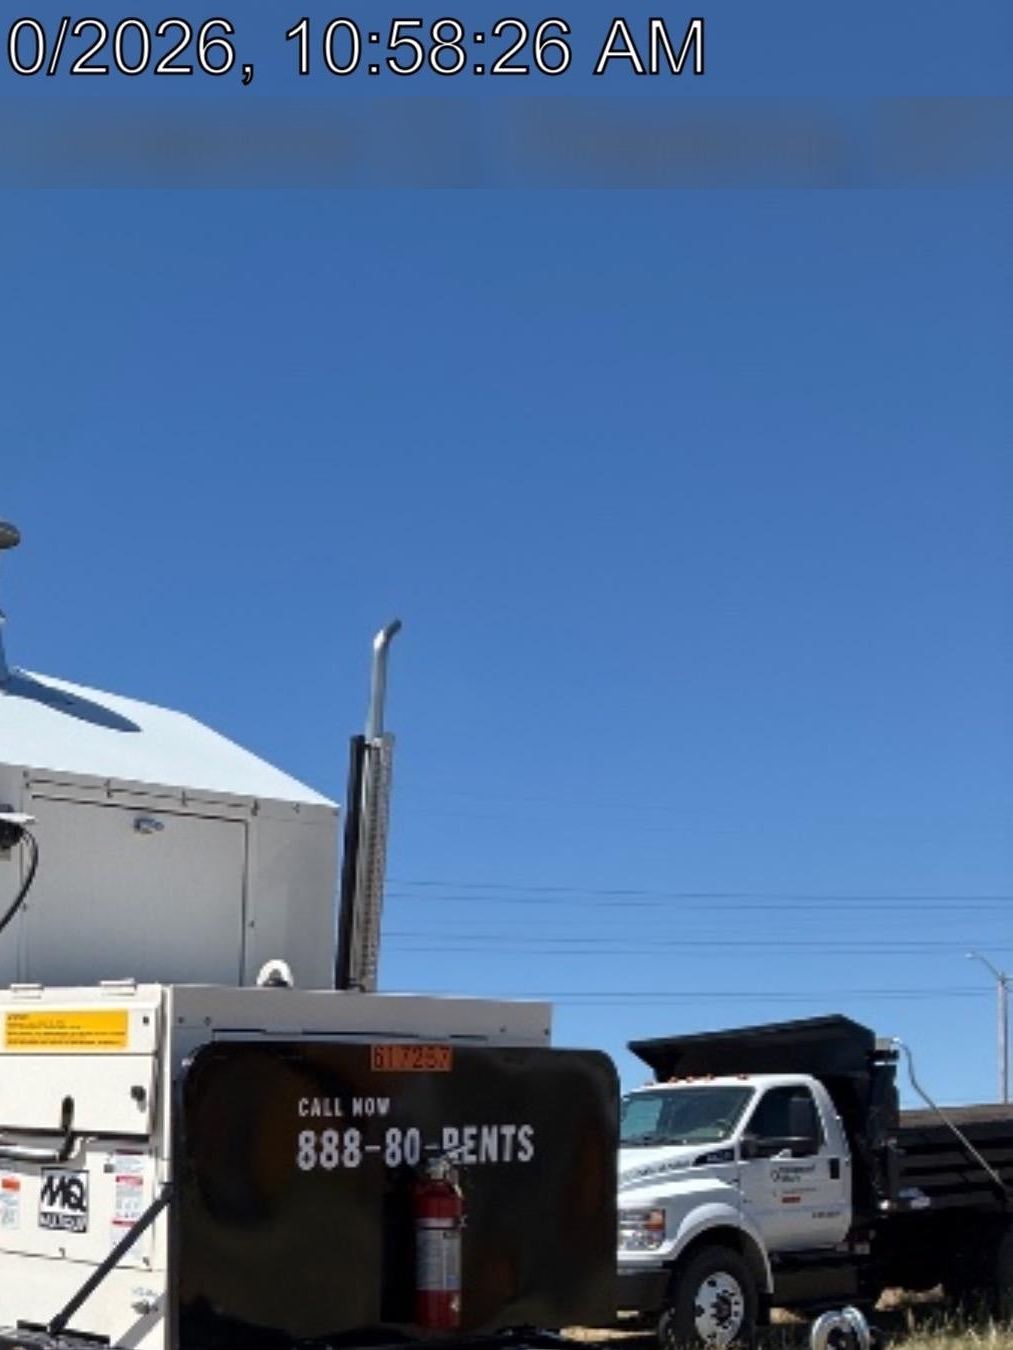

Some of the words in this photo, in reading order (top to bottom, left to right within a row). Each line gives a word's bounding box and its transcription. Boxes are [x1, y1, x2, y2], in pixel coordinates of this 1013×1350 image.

[298, 1097, 343, 1117] CALL
[352, 1097, 391, 1116] NOW
[41, 1175, 86, 1211] MQ
